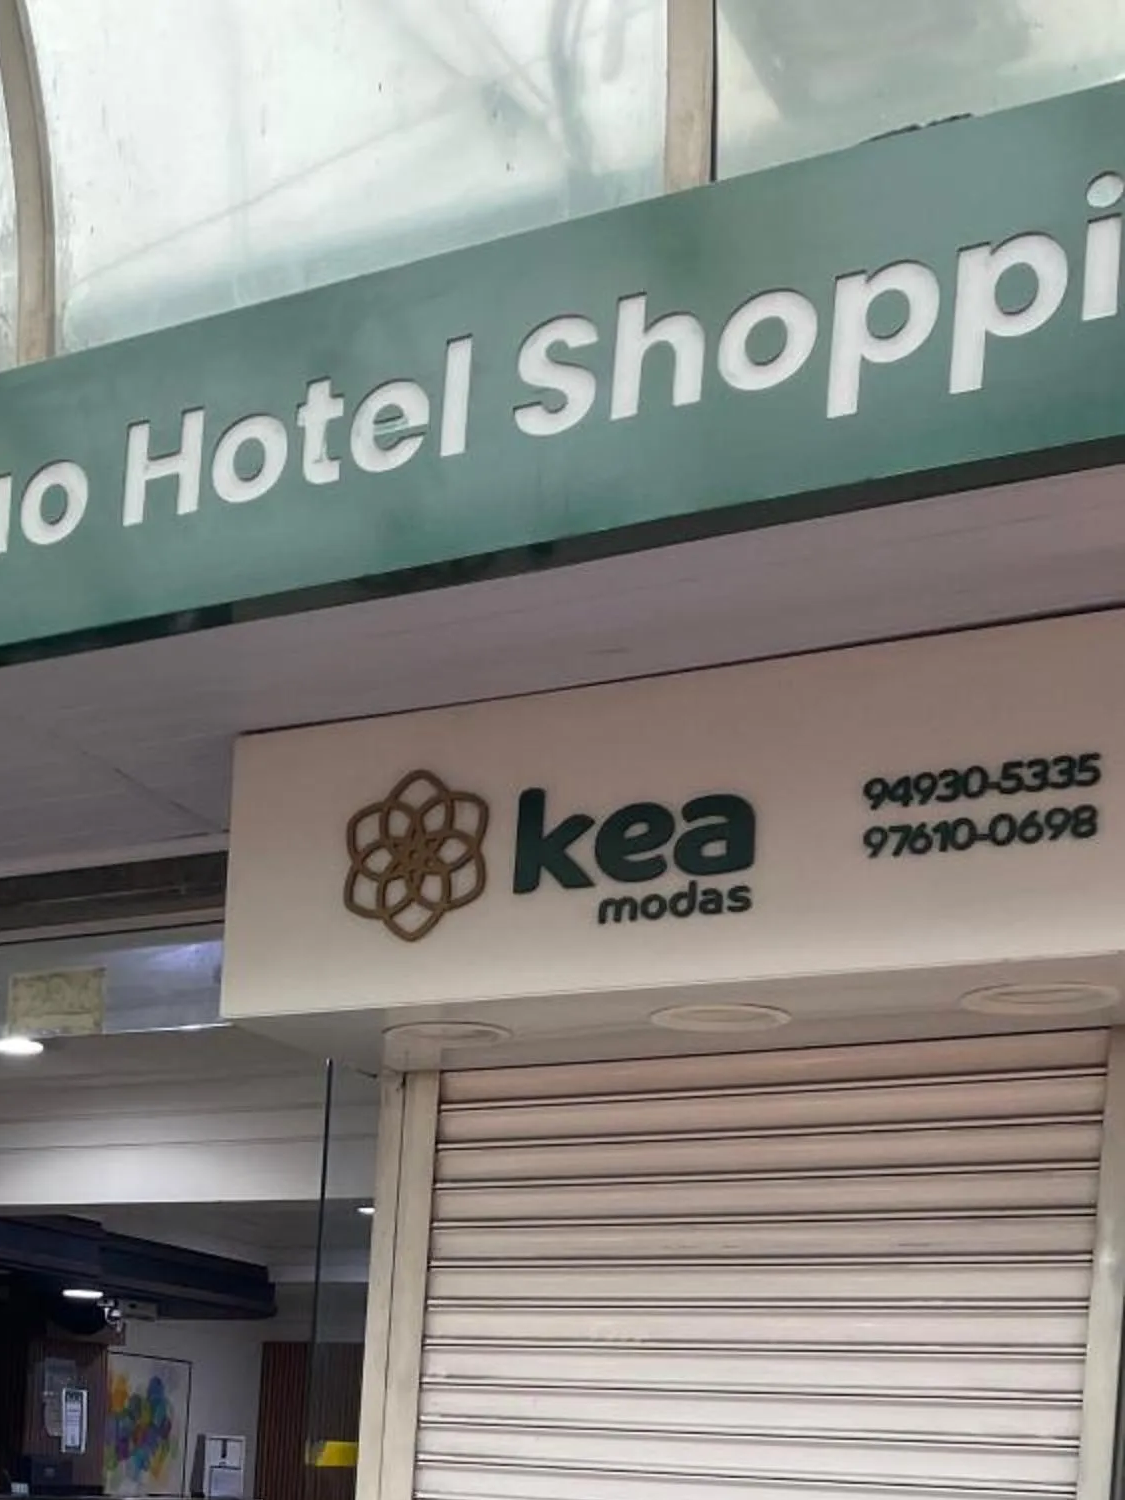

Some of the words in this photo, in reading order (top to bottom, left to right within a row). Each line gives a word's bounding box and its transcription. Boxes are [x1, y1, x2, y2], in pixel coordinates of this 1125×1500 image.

[122, 336, 471, 526] Hotel
[512, 172, 1125, 437] Shoppi
[862, 752, 1102, 811] 94930-5335
[512, 788, 756, 894] kea
[862, 804, 1100, 858] 97610-0698
[597, 881, 752, 924] modas
